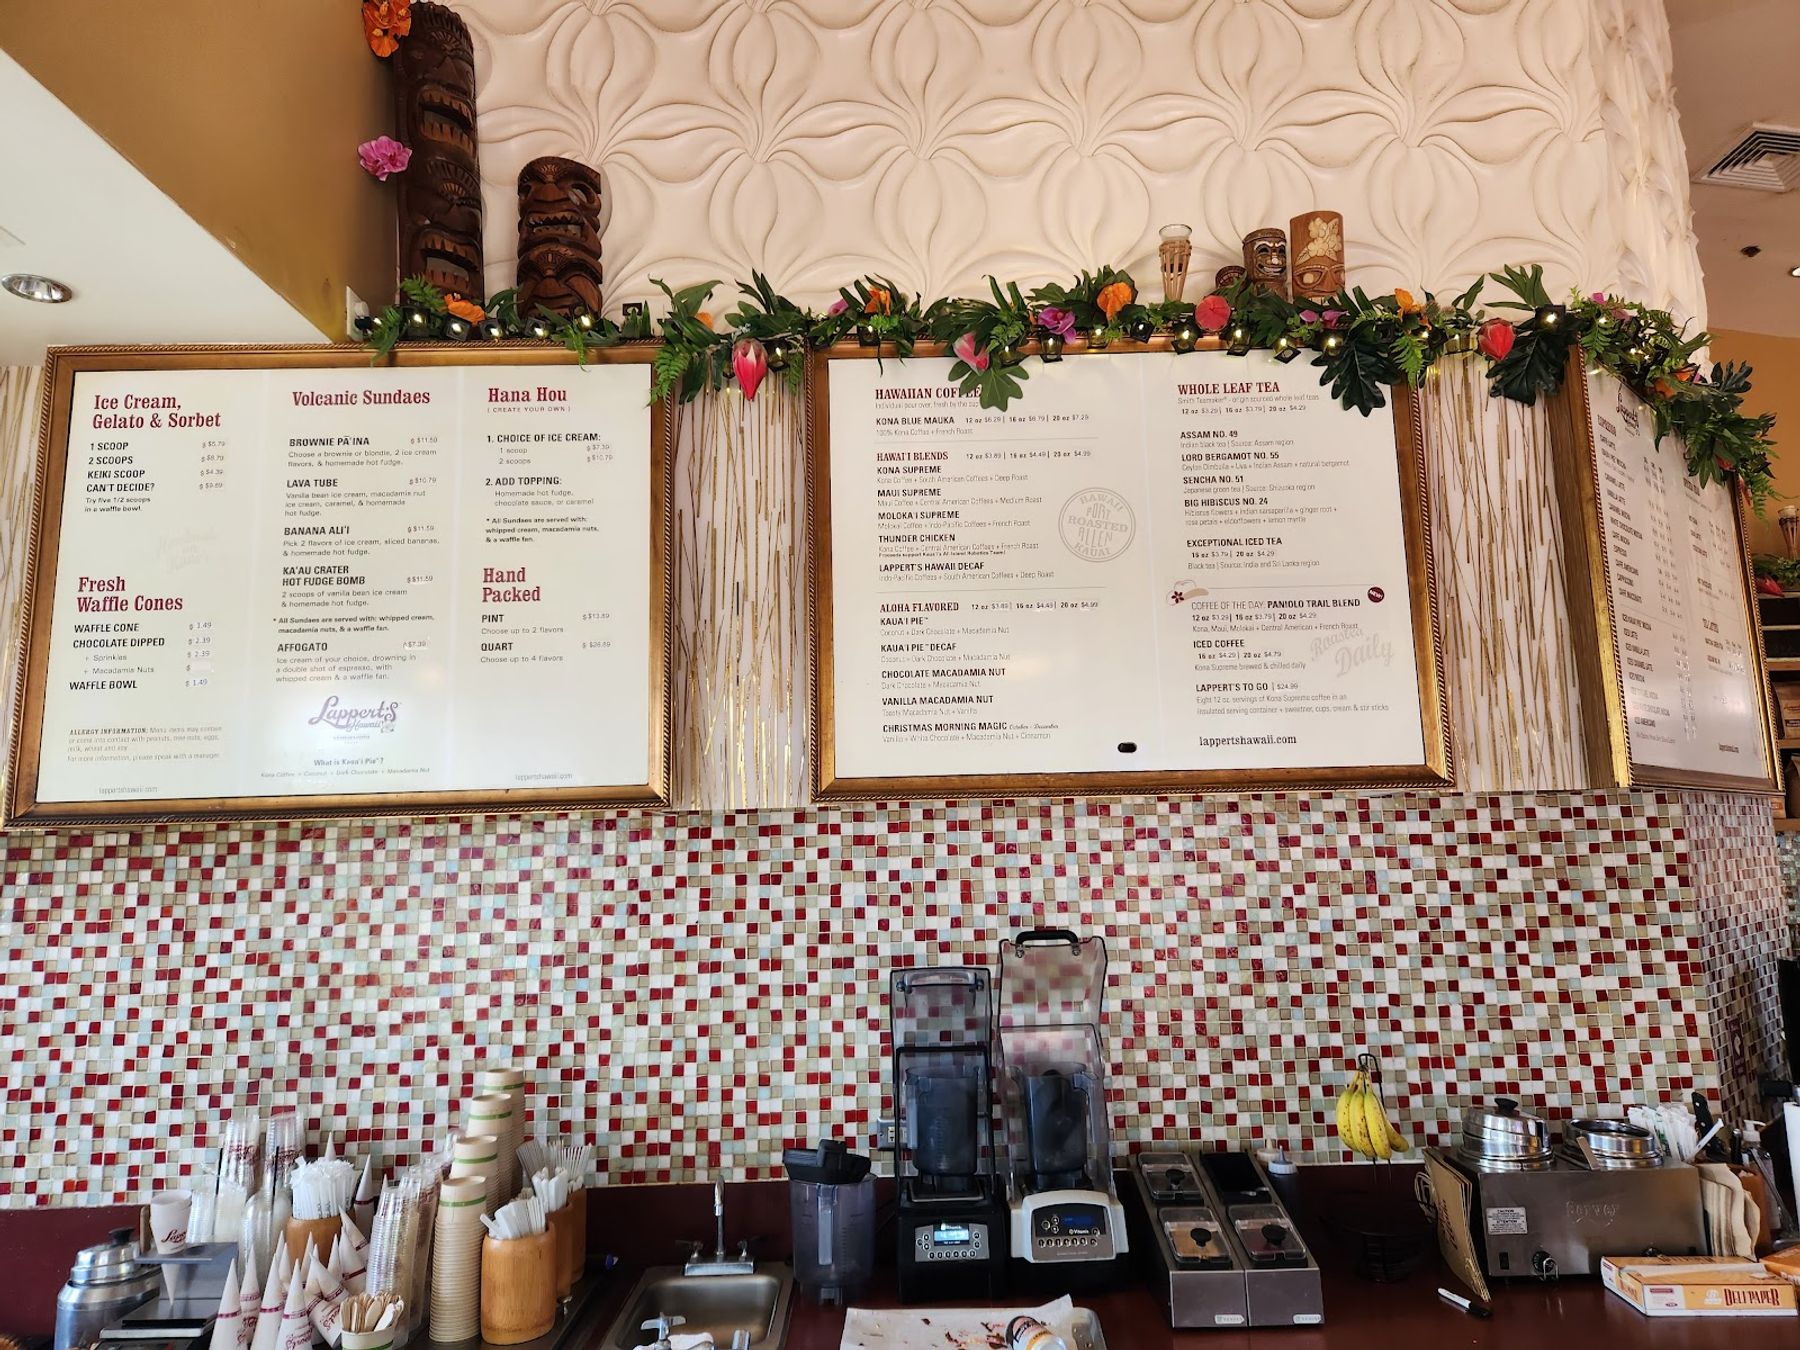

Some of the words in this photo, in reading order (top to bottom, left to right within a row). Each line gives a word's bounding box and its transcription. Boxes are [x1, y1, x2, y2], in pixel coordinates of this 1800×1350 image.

[1178, 384, 1220, 395] WHOLE
[1223, 383, 1253, 394] LEAF
[1256, 382, 1280, 393] TEA
[292, 391, 357, 406] Volcanic
[363, 390, 430, 404] Sundaes
[488, 388, 530, 403] Hana
[537, 387, 567, 402] Hou
[875, 388, 932, 400] HAWAIIAN
[94, 395, 118, 410] Ice
[124, 394, 181, 411] Cream,
[93, 414, 144, 429] Gelato
[150, 414, 162, 428] &
[168, 412, 221, 428] Sorbet
[902, 417, 922, 425] BLUE
[924, 416, 955, 424] MAUKA
[534, 434, 545, 442] OF
[548, 434, 562, 442] ICE
[565, 433, 600, 441] CREAM:
[1180, 431, 1211, 439] ASSAM
[1229, 430, 1238, 438] 49
[289, 438, 334, 447] BROWNIE
[89, 457, 94, 465] 2
[96, 456, 133, 465] SCOOPS
[913, 452, 948, 460] BLENDS
[1182, 454, 1203, 462] LORD
[87, 471, 111, 479] KEIKI
[114, 470, 145, 479] SCOOP
[903, 466, 941, 474] SUPREME
[287, 480, 310, 488] LAVA
[314, 479, 338, 487] TUBE
[486, 478, 492, 486] 2.
[495, 478, 515, 486] ADD
[518, 477, 562, 485] TOPPING:
[1183, 476, 1217, 484] SENCHA
[1235, 475, 1244, 483] 51
[117, 483, 155, 492] DECIDE?
[877, 489, 900, 497] MAUI
[902, 489, 941, 497] SUPREME
[1185, 499, 1199, 507] BIG
[1201, 499, 1240, 507] HIBISCUS
[920, 511, 959, 519] SUPREME
[284, 527, 326, 535] BANANA
[879, 535, 917, 543] THUNDER
[1187, 538, 1243, 547] EXCEPTIONAL
[1246, 538, 1264, 546] ICED
[1267, 537, 1282, 545] TEA
[314, 566, 349, 574] CRATER
[958, 562, 985, 570] DECAF
[483, 567, 526, 583] Hand
[78, 576, 126, 592] Fresh
[282, 578, 300, 586] HOT
[303, 577, 334, 586] FUDGE
[336, 576, 365, 585] BOMB
[482, 586, 541, 603] Packed
[77, 597, 129, 613] Waffle
[134, 595, 183, 611] Cones
[880, 604, 910, 613] ALOHA
[913, 602, 959, 611] FLAVORED
[1191, 602, 1219, 610] COFFEE
[1233, 601, 1247, 609] THE
[1267, 600, 1304, 609] PANIOLO
[1307, 600, 1330, 608] TRAIL
[1332, 599, 1360, 607] BLEND
[482, 615, 504, 623] PINT
[74, 624, 111, 633] WAFFLE
[114, 624, 139, 632] CONE
[73, 639, 128, 648] CHOCOLATE
[131, 638, 165, 647] DIPPED
[277, 643, 328, 652] AFFOGATO
[481, 643, 513, 651] QUART
[930, 643, 957, 651] DECAF
[1193, 640, 1212, 648] ICED
[1215, 639, 1245, 648] COFFEE
[1335, 634, 1394, 677] Daily
[882, 670, 930, 679] CHOCOLATE
[932, 669, 986, 677] MACADAMIA
[989, 668, 1005, 676] NUT
[69, 681, 107, 690] WAFFLE
[109, 681, 138, 689] BOWL
[1243, 683, 1254, 691] TO
[882, 697, 917, 706] VANILLA
[919, 696, 974, 705] MACADAMIA
[976, 695, 994, 704] NUT
[883, 724, 932, 733] CHRISTMAS
[935, 723, 977, 731] MORNING
[979, 722, 1007, 731] MAGIC
[1200, 735, 1297, 747] lappertshawaii.com
